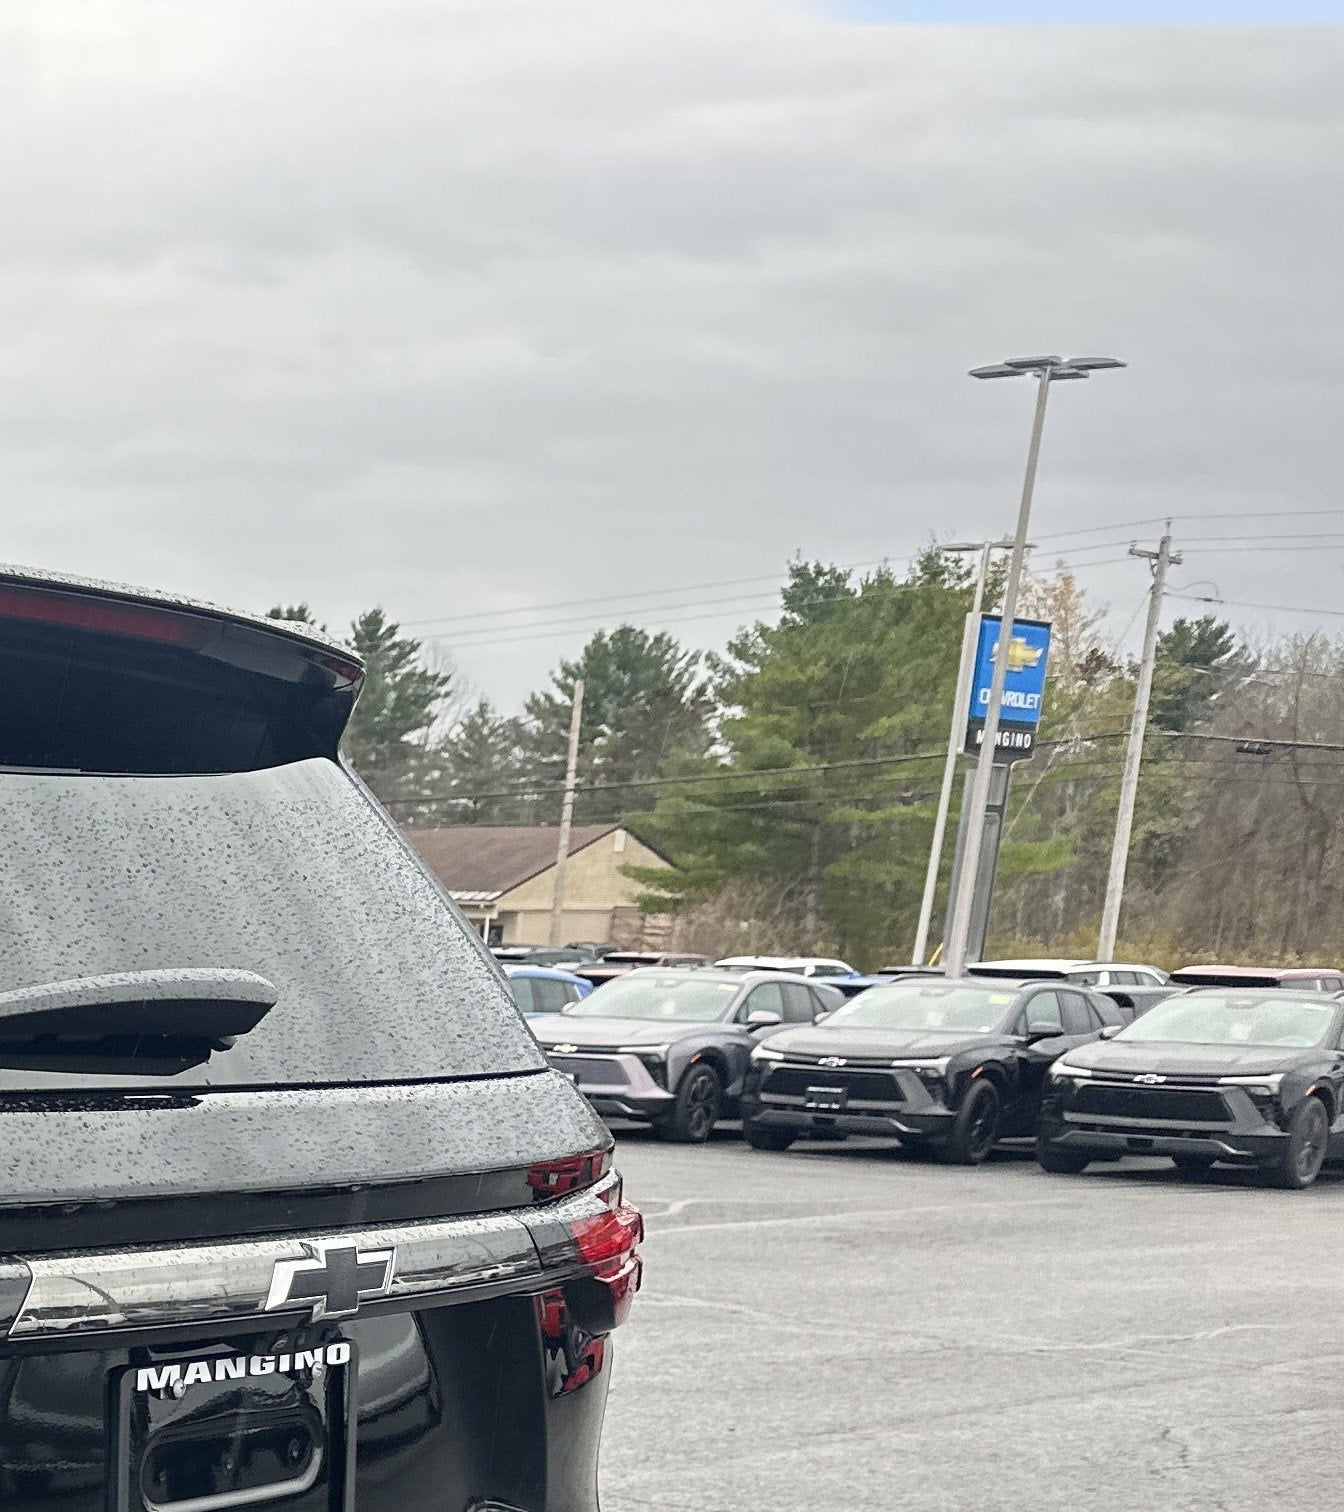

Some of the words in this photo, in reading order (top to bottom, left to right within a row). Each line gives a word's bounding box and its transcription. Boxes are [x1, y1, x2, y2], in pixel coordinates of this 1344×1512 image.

[979, 688, 1040, 709] CVROLET
[976, 729, 1031, 748] MNGINO
[137, 1343, 351, 1391] MANGINO
